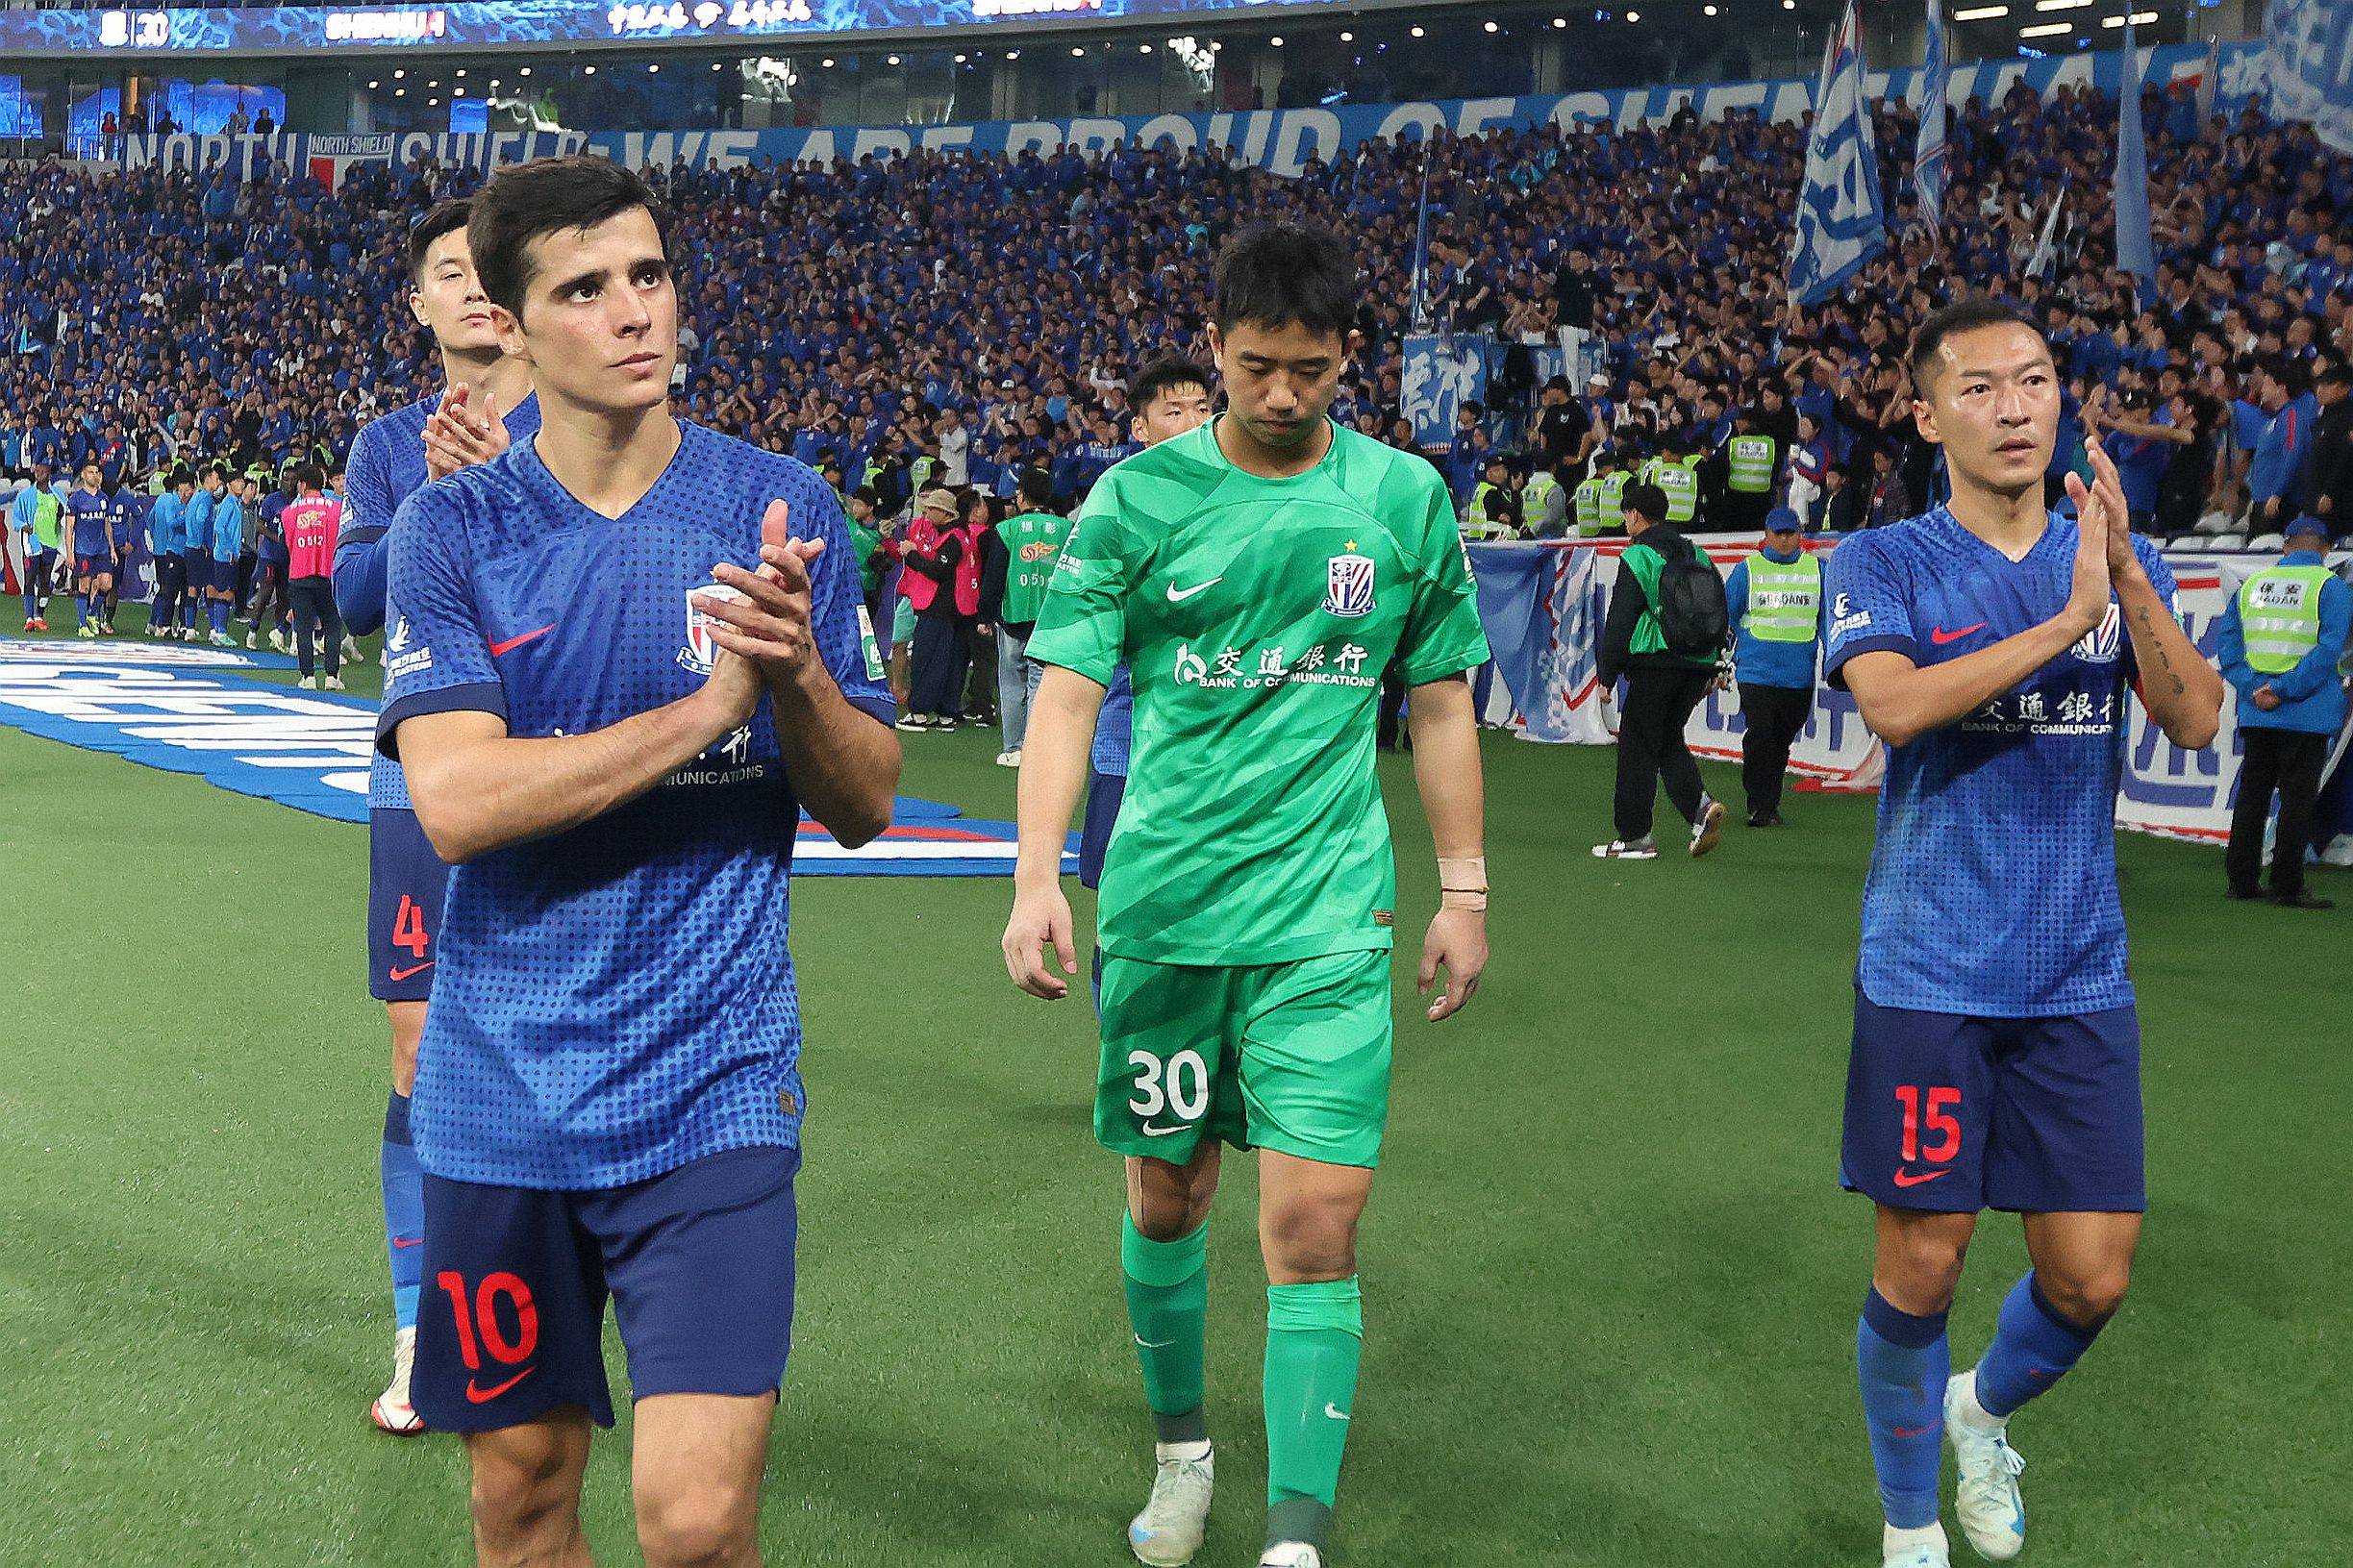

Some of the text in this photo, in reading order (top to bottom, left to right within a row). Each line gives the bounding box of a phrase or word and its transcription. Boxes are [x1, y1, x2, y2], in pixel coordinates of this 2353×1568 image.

[1199, 672, 1376, 689] BANK OF COMUNICATIONS
[392, 893, 429, 958] 4
[1128, 1049, 1209, 1120] 30
[1895, 1084, 1962, 1163] 15
[437, 1270, 539, 1370] 10
